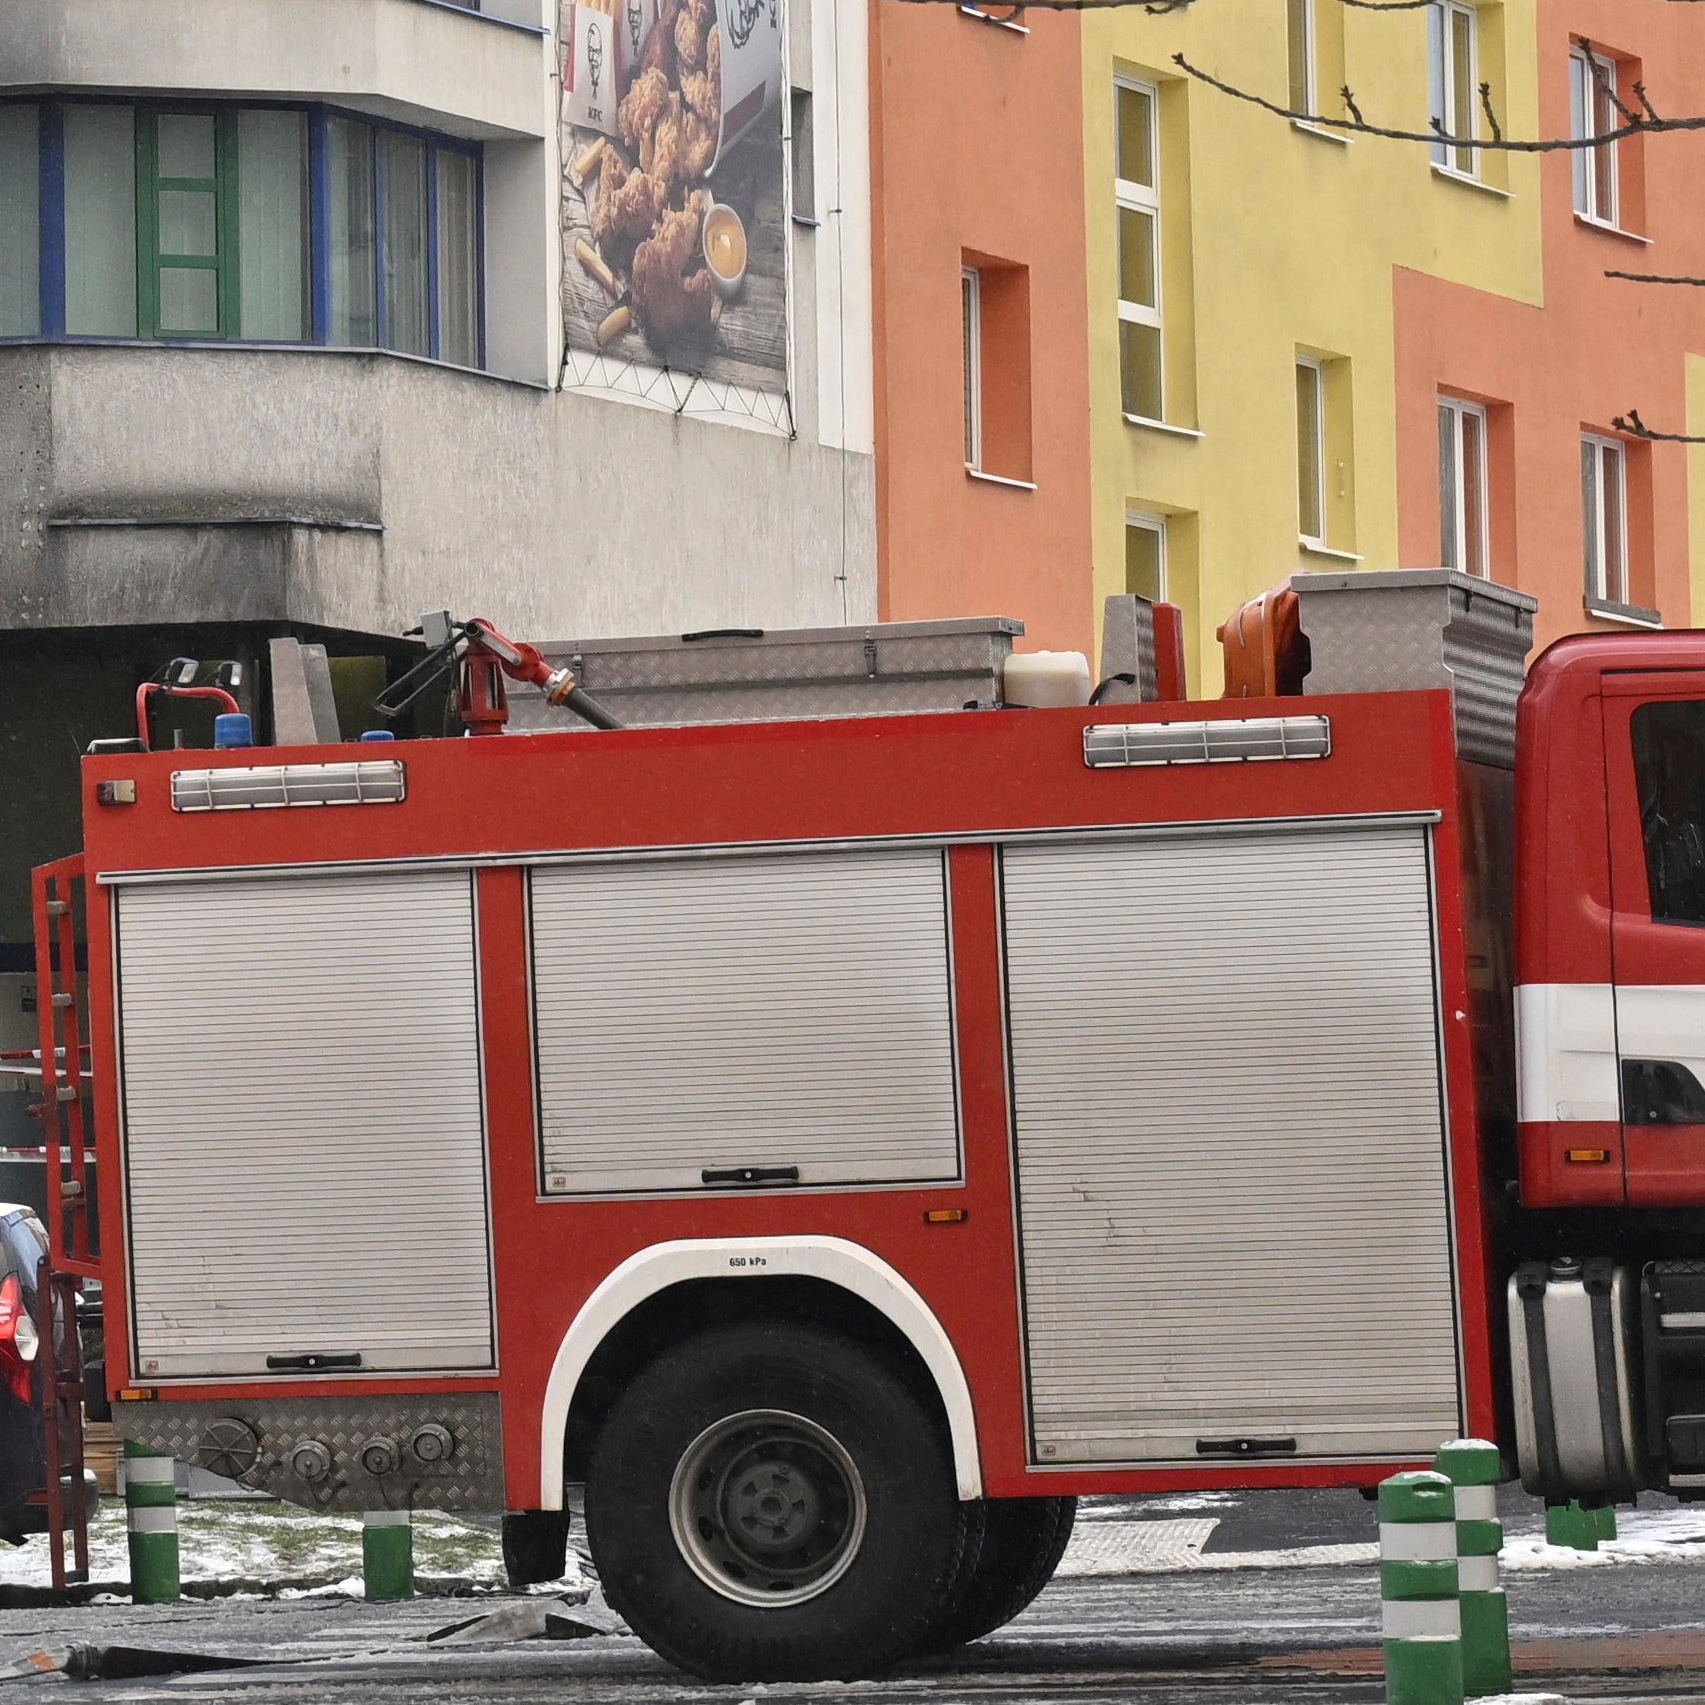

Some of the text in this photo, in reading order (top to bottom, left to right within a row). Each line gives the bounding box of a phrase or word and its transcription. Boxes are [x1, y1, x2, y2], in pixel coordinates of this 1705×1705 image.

[588, 106, 603, 123] KFC
[729, 1256, 767, 1267] 650 kPa
